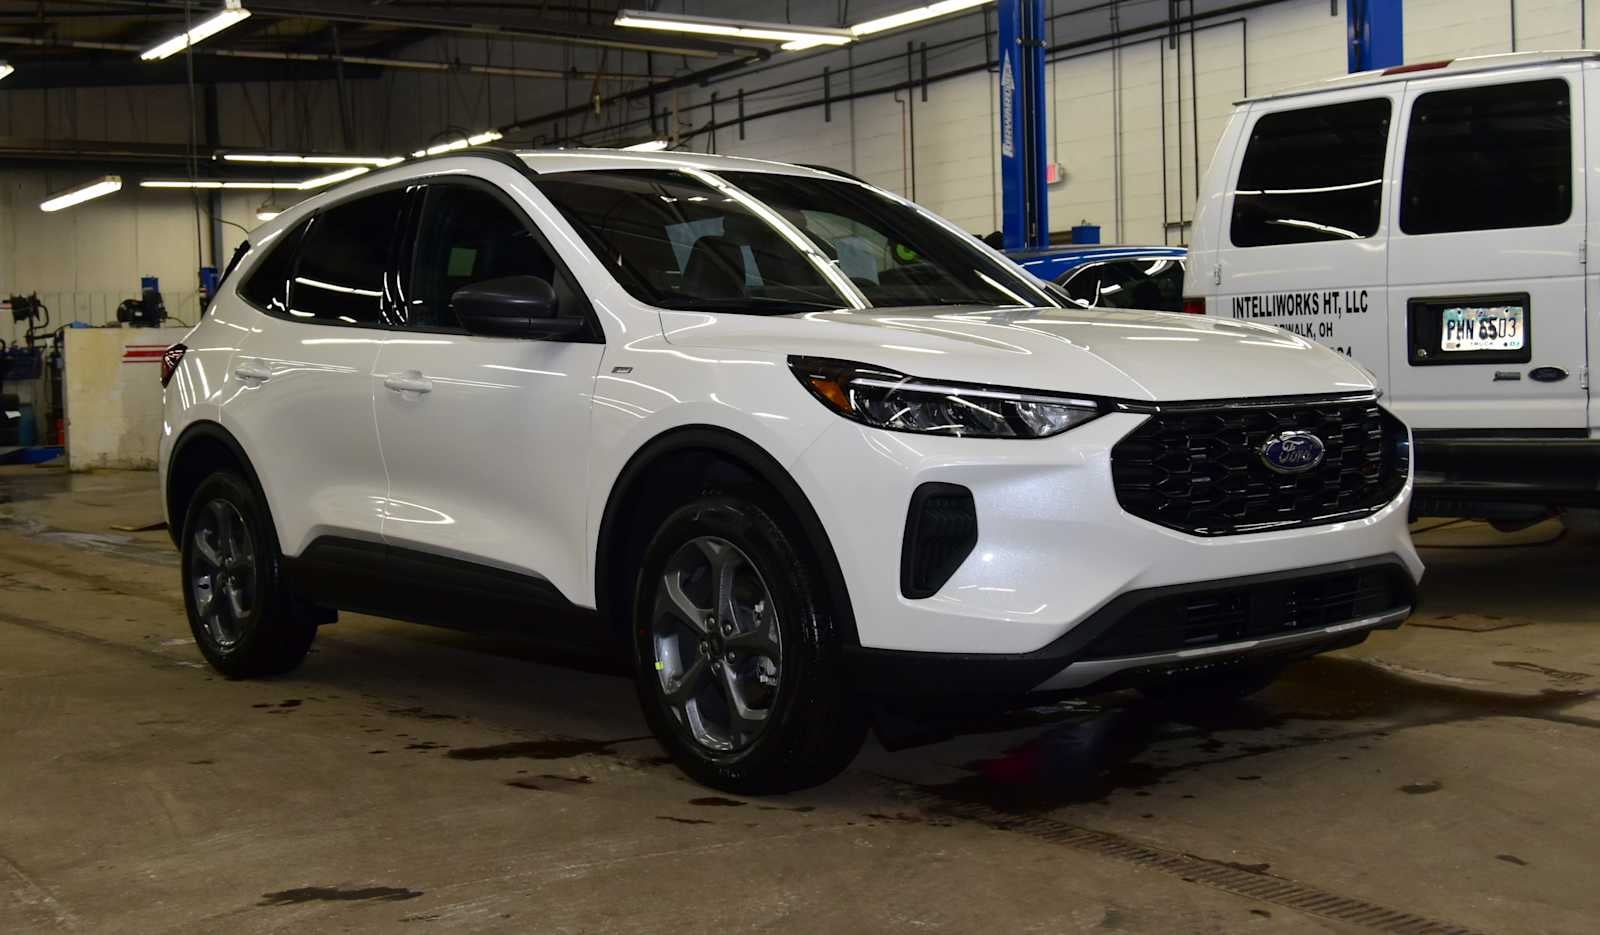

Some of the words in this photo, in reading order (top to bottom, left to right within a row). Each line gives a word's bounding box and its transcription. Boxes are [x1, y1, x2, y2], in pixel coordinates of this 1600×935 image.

[1232, 291, 1319, 318] INTELLIWORKS
[1323, 291, 1341, 319] HT,
[1346, 289, 1368, 313] LLC
[1274, 322, 1316, 341] WALK,
[1319, 322, 1333, 337] OH
[1279, 439, 1313, 464] Ford
